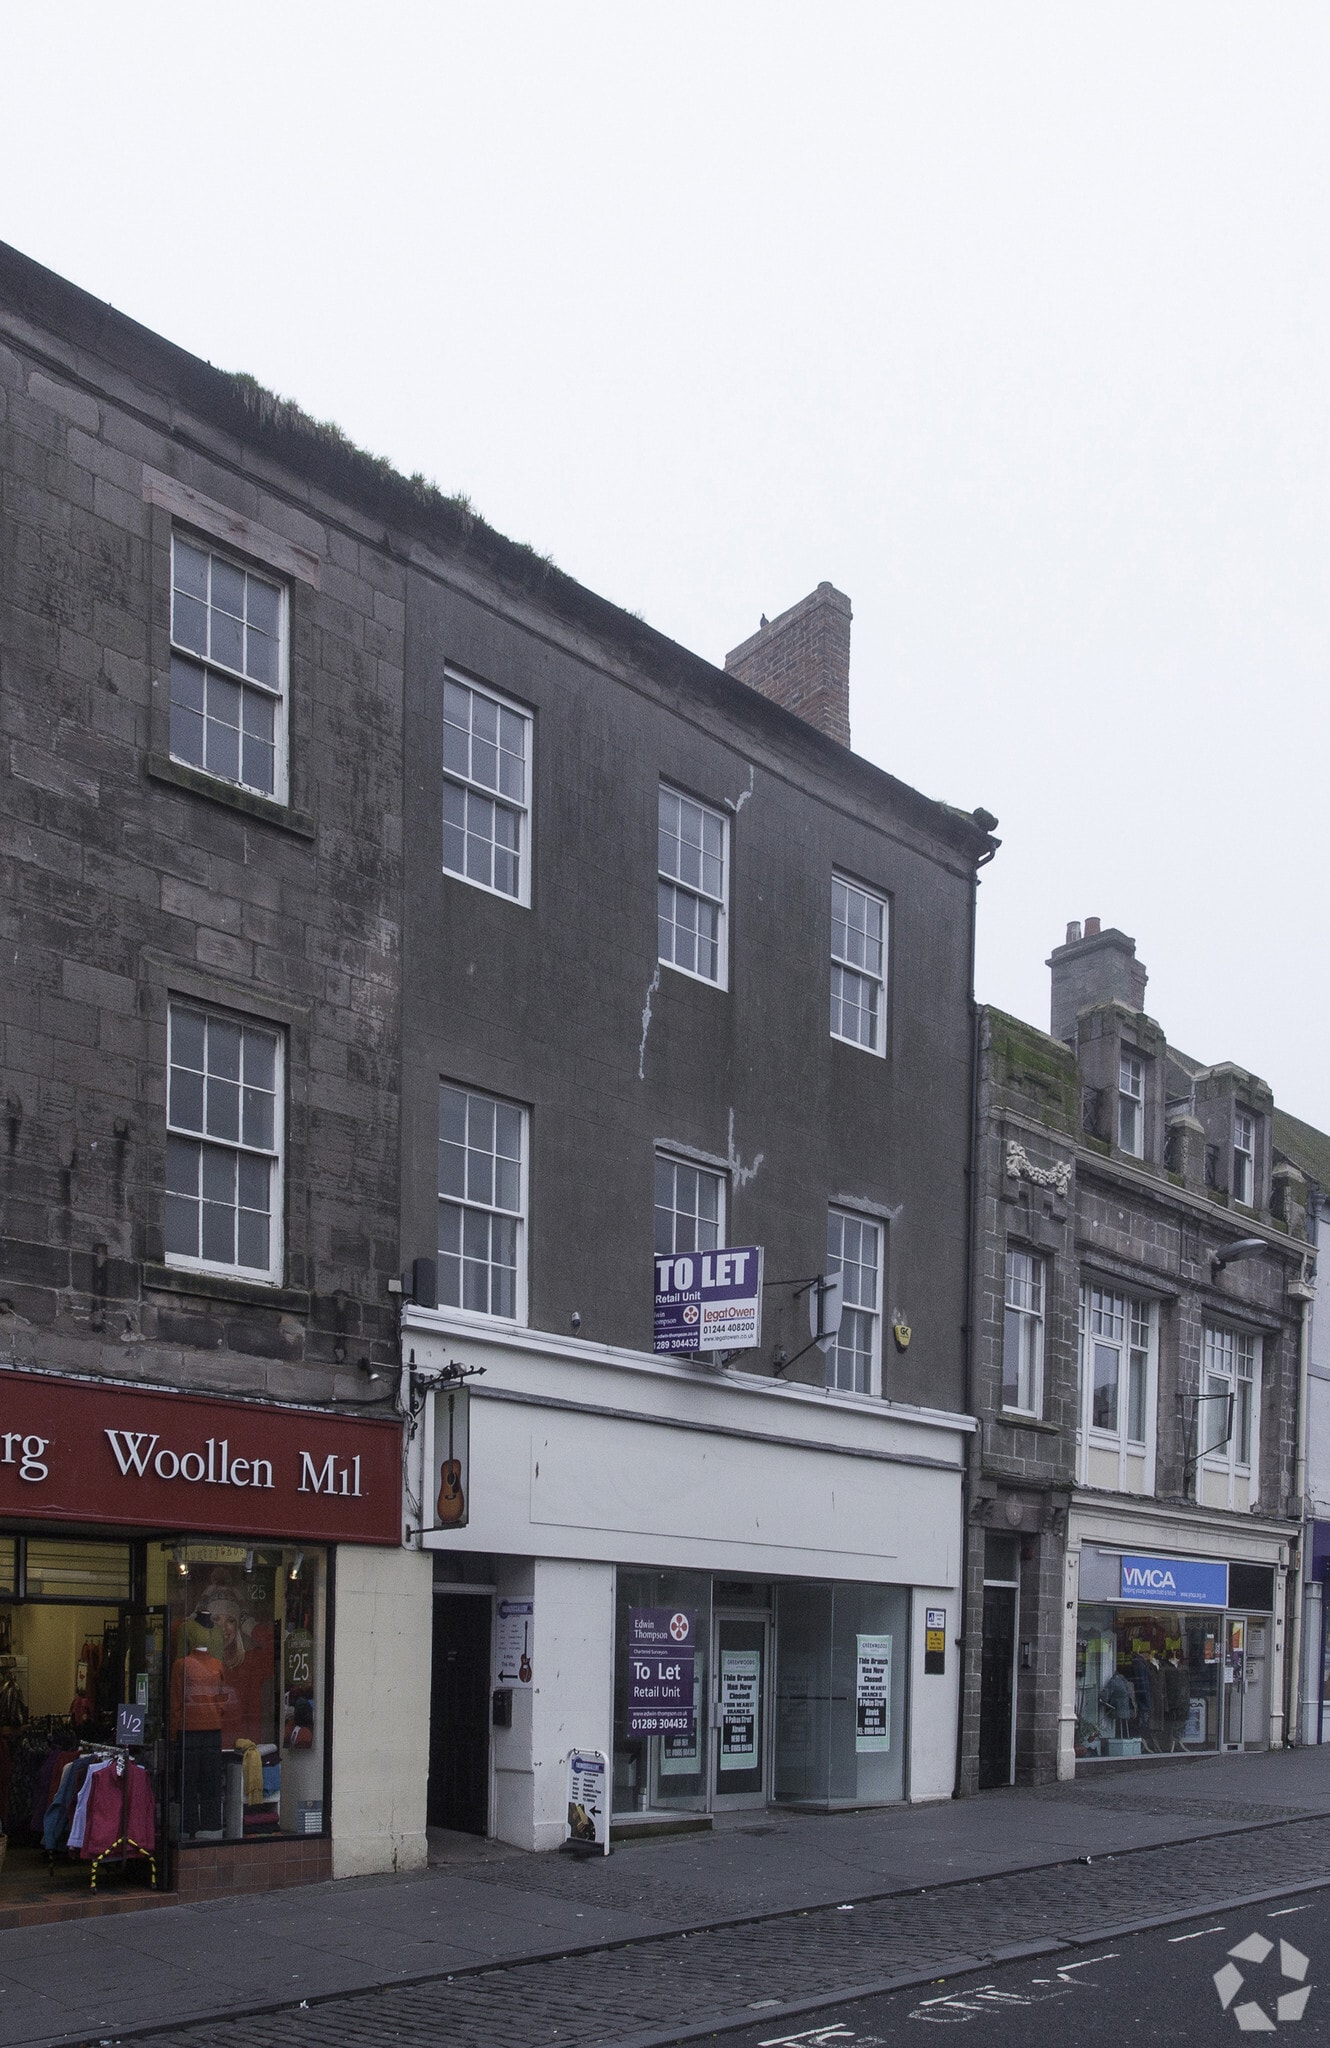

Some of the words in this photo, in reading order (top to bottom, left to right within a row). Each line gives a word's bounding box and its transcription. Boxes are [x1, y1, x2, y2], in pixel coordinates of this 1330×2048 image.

[656, 1258, 694, 1292] TO
[702, 1252, 750, 1288] LET
[655, 1293, 680, 1303] Retail
[682, 1291, 701, 1301] Unit
[703, 1325, 726, 1334] 01244
[728, 1322, 755, 1332] 408200
[671, 1338, 699, 1349] 304432
[0, 1431, 50, 1482] rg
[103, 1428, 276, 1488] Woollen
[1123, 1567, 1176, 1589] YMCA
[634, 1619, 655, 1629] Edwin
[634, 1629, 668, 1642] Thompson
[289, 1653, 309, 1681] £25
[870, 1657, 888, 1665] Branch
[633, 1661, 650, 1680] To
[658, 1662, 681, 1680] Let
[633, 1686, 659, 1698] Retail
[662, 1686, 681, 1698] Unit
[120, 1710, 142, 1733] 1/2
[631, 1718, 657, 1730] 01289
[659, 1718, 688, 1729] 304432
